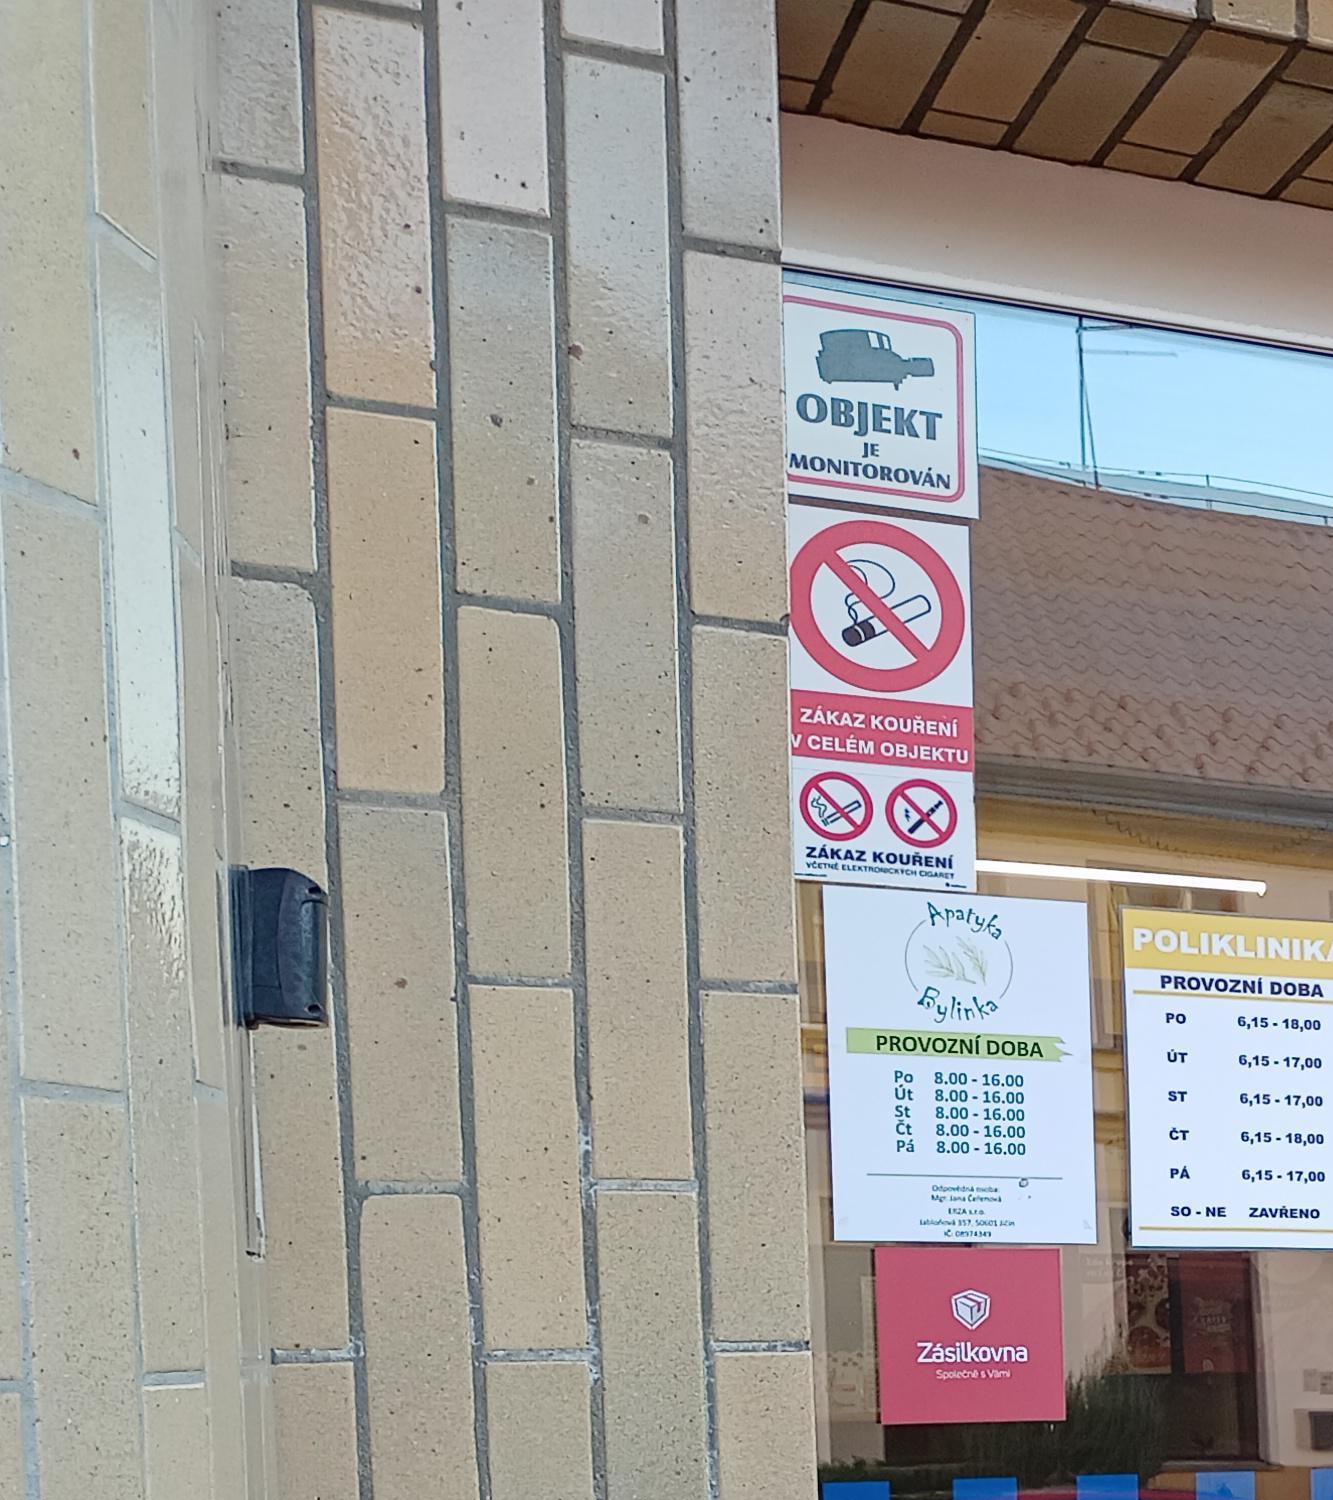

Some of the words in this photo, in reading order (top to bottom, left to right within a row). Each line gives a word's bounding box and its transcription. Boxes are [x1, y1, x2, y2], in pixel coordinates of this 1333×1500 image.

[796, 393, 943, 441] OBJEKT
[862, 442, 879, 458] JE
[789, 453, 951, 489] MONITOROVÁN
[800, 706, 865, 729] ZÁKAZ
[871, 715, 958, 737] KOUŘENÍ
[791, 735, 802, 747] V
[807, 732, 875, 756] CELÉM
[880, 742, 969, 764] OBJEKTU
[805, 844, 867, 862] ZÁKAZ
[872, 852, 954, 869] KOUŘENÍ
[927, 901, 1002, 940] Apatyka
[1160, 975, 1263, 995] PROVOZNÍ
[1269, 982, 1324, 998] DOBA
[917, 986, 999, 1023] Bylinka
[1165, 1013, 1187, 1024] PO
[1238, 1017, 1268, 1030] 6,15
[1282, 1019, 1321, 1032] 18,00
[876, 1034, 980, 1055] PROVOZNÍ
[986, 1040, 1044, 1057] DOBA
[1167, 1050, 1188, 1063] ÚT
[1239, 1055, 1269, 1068] 6,15
[1283, 1057, 1322, 1070] 17,00
[894, 1070, 913, 1083] Po
[934, 1072, 967, 1085] 8.00
[982, 1074, 1024, 1087] 16.00
[895, 1085, 913, 1101] Út
[935, 1089, 968, 1102] 8.00
[983, 1091, 1024, 1104] 16.00
[1168, 1091, 1187, 1102] ST
[1240, 1093, 1270, 1106] 6,15
[1284, 1095, 1323, 1108] 17,00
[895, 1105, 911, 1118] St
[935, 1107, 968, 1120] 8.00
[983, 1109, 1025, 1121] 16.00
[896, 1120, 912, 1135] Čt
[936, 1124, 969, 1137] 8.00
[984, 1126, 1025, 1139] 16.00
[1169, 1128, 1189, 1141] ČT
[1241, 1132, 1272, 1145] 6,15
[1285, 1133, 1324, 1146] 18,00
[896, 1140, 915, 1153] Pá
[937, 1141, 970, 1154] 8.00
[984, 1143, 1026, 1156] 16.00
[1170, 1166, 1190, 1179] PÁ
[1242, 1170, 1273, 1183] 6,15
[1287, 1171, 1325, 1184] 17,00
[1170, 1206, 1191, 1217] SO
[1205, 1207, 1227, 1218] NE
[1249, 1205, 1320, 1219] ZAVŘENO
[917, 1341, 1028, 1363] Zásilkovna
[936, 1369, 979, 1380] Společně
[987, 1369, 1011, 1379] Vámi
